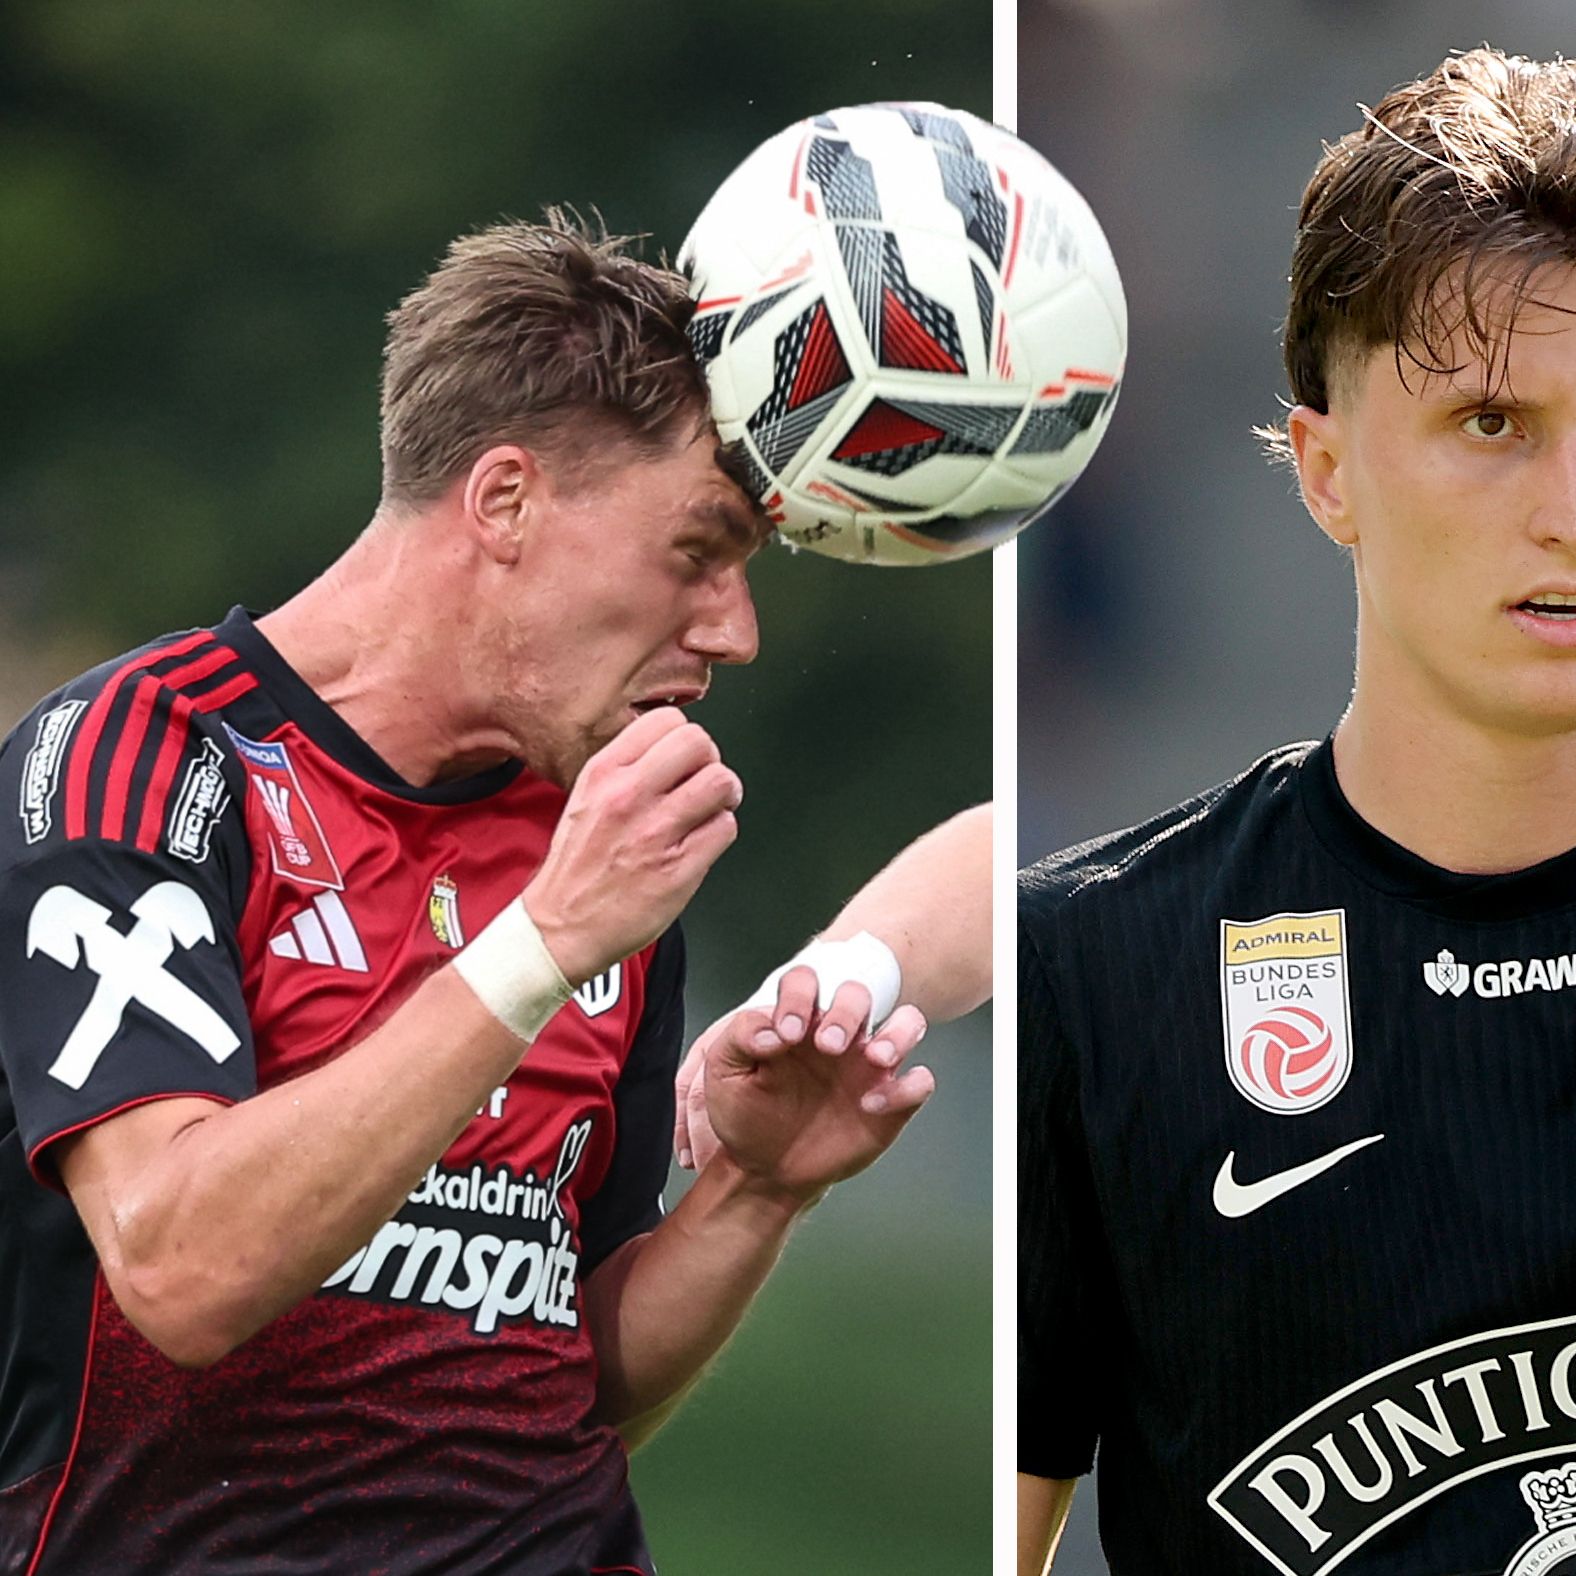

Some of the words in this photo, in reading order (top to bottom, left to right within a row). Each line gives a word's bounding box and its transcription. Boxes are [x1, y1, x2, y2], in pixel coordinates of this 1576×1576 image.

[175, 754, 216, 855] TECHNOGY
[1232, 928, 1335, 953] ADMIRAL
[1231, 961, 1337, 986] BUNDES
[1256, 982, 1315, 1003] LIGA
[321, 1217, 579, 1333] rnspitz
